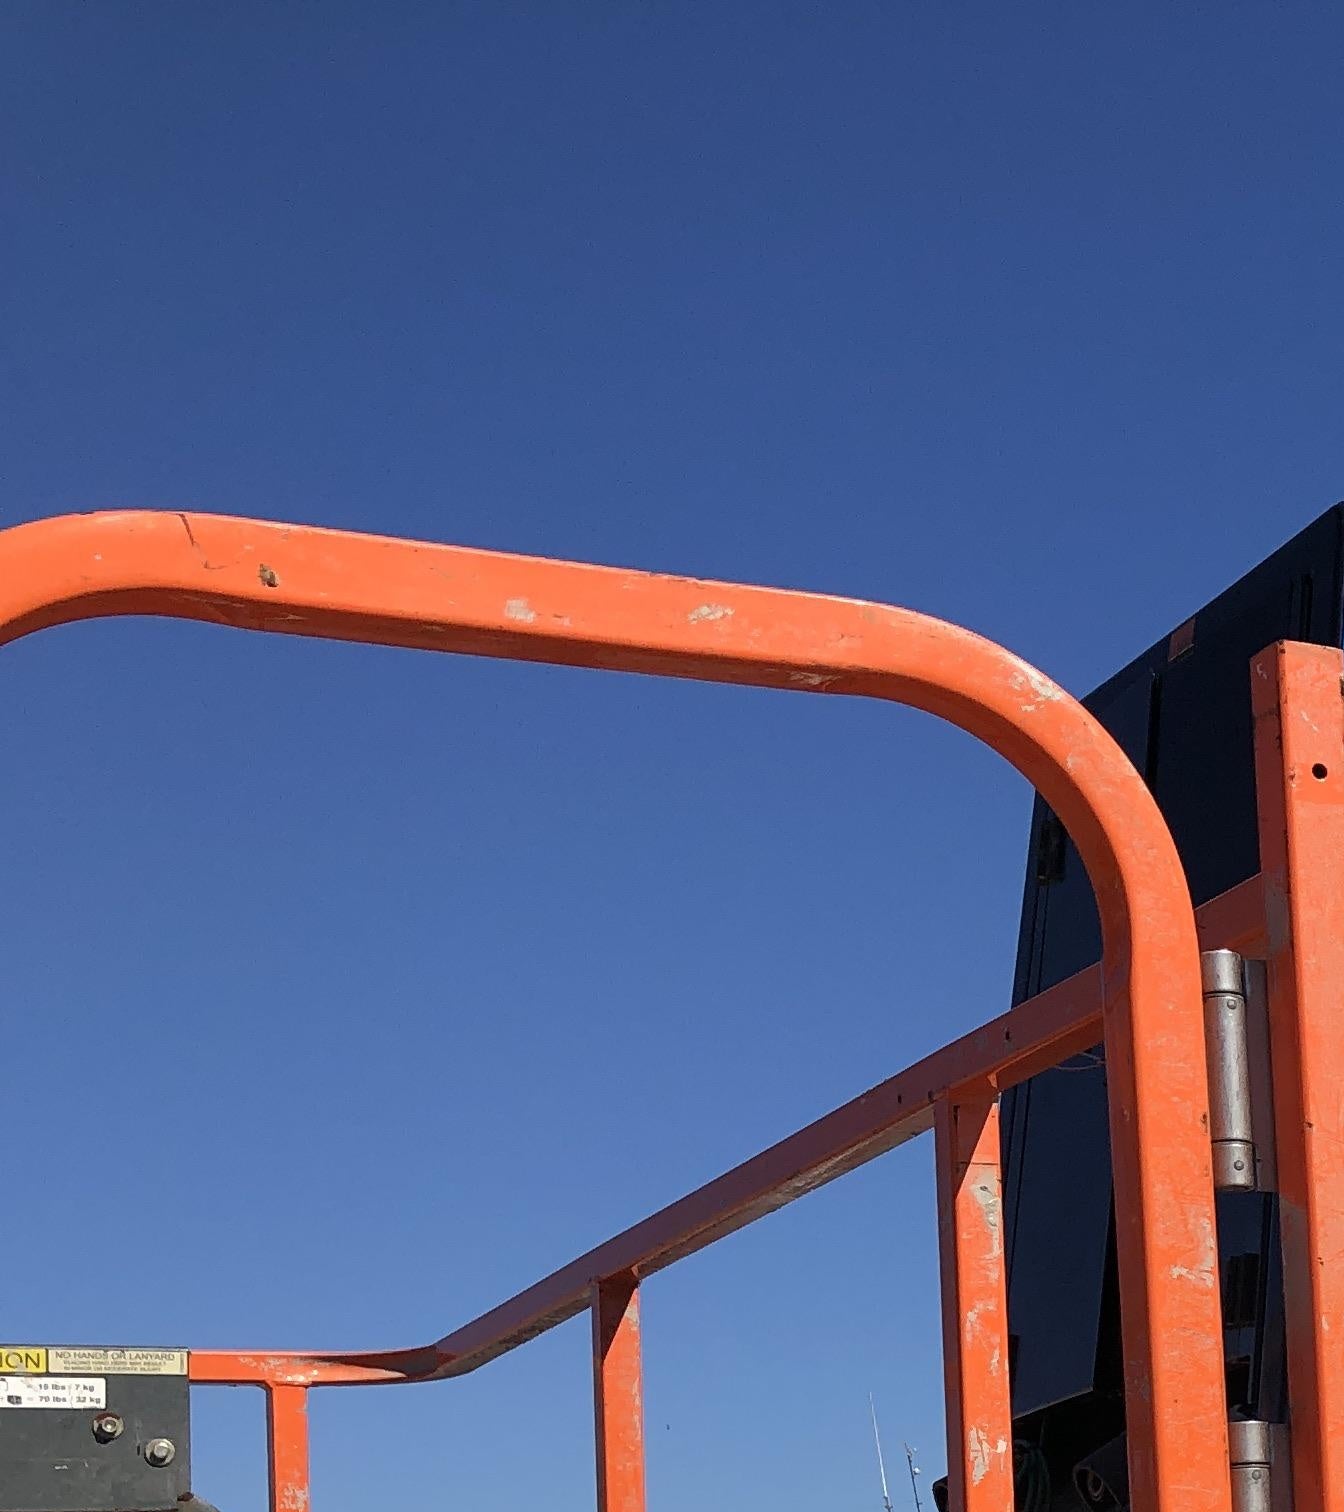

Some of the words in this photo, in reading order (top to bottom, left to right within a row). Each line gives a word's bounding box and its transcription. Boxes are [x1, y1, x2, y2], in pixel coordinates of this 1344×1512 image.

[55, 1351, 71, 1359] NO
[73, 1351, 107, 1360] HANDS
[128, 1352, 175, 1361] LANYARD
